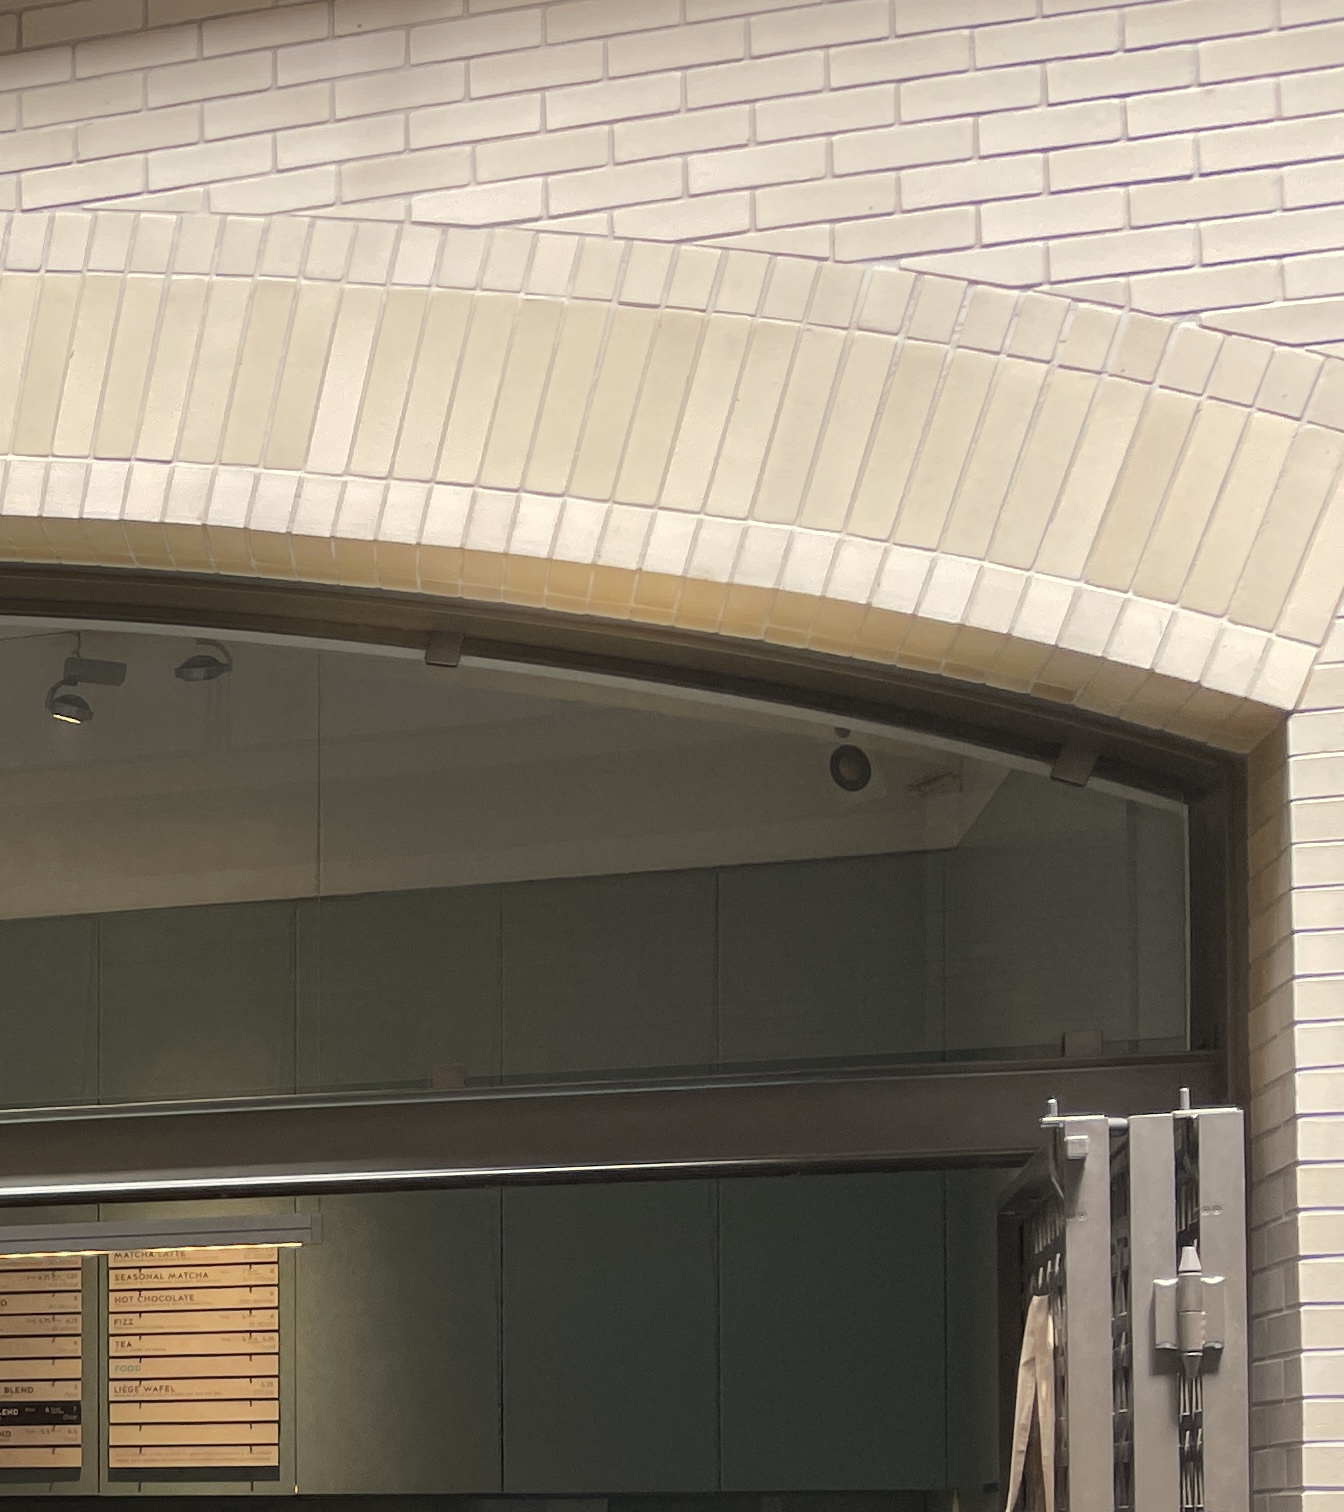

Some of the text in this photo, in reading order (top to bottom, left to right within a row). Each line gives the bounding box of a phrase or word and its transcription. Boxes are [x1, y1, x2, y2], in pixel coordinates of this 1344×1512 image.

[114, 1272, 209, 1281] SEASONAL MATCHA
[114, 1294, 194, 1304] HOT CHOCOLATE
[114, 1318, 134, 1326] FIZZ
[4, 1386, 34, 1394] BLEND
[143, 1384, 175, 1393] WAFEL
